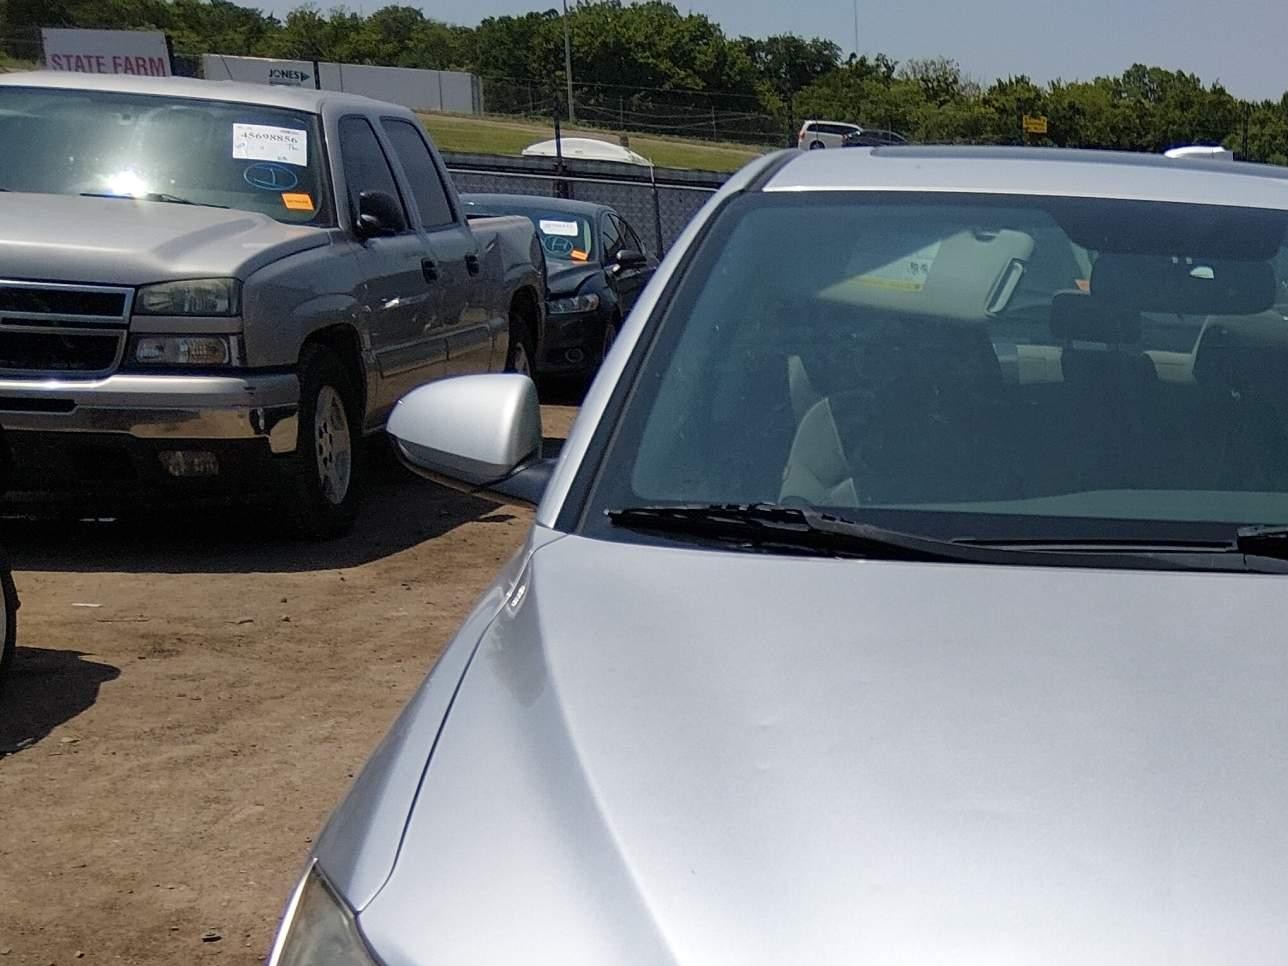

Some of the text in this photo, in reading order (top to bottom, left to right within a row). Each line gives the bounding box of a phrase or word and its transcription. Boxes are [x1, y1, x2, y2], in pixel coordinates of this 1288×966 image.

[50, 53, 167, 77] STATE FARM
[269, 69, 300, 80] JONES
[240, 131, 299, 144] 45698856
